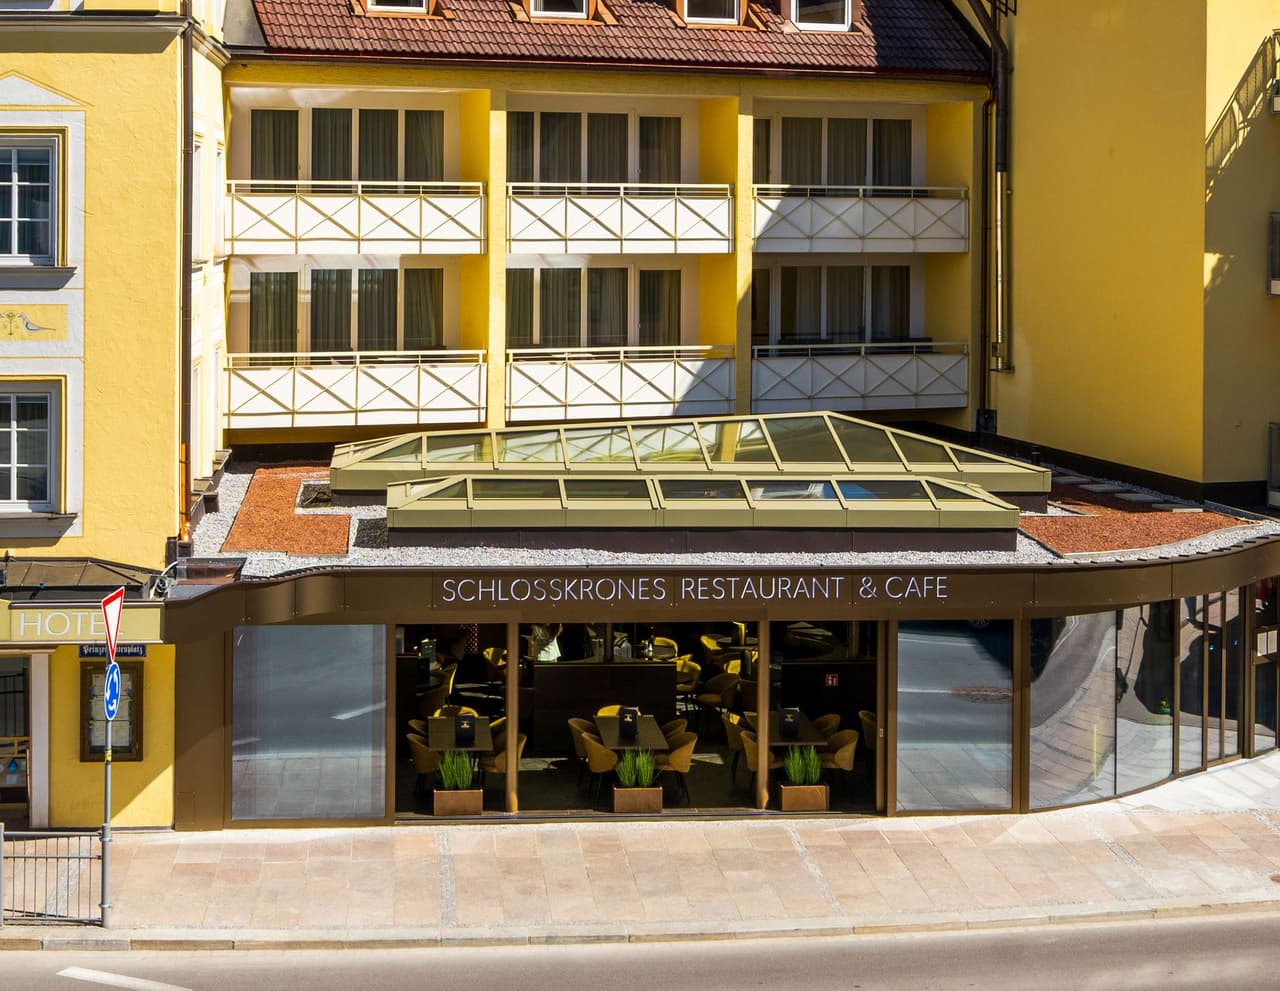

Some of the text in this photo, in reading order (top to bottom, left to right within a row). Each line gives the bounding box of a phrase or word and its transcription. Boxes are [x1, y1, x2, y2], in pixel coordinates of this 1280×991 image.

[442, 576, 948, 602] SCHLOSSKRONES RESTAURANT & CAFE
[19, 611, 125, 637] HOTE
